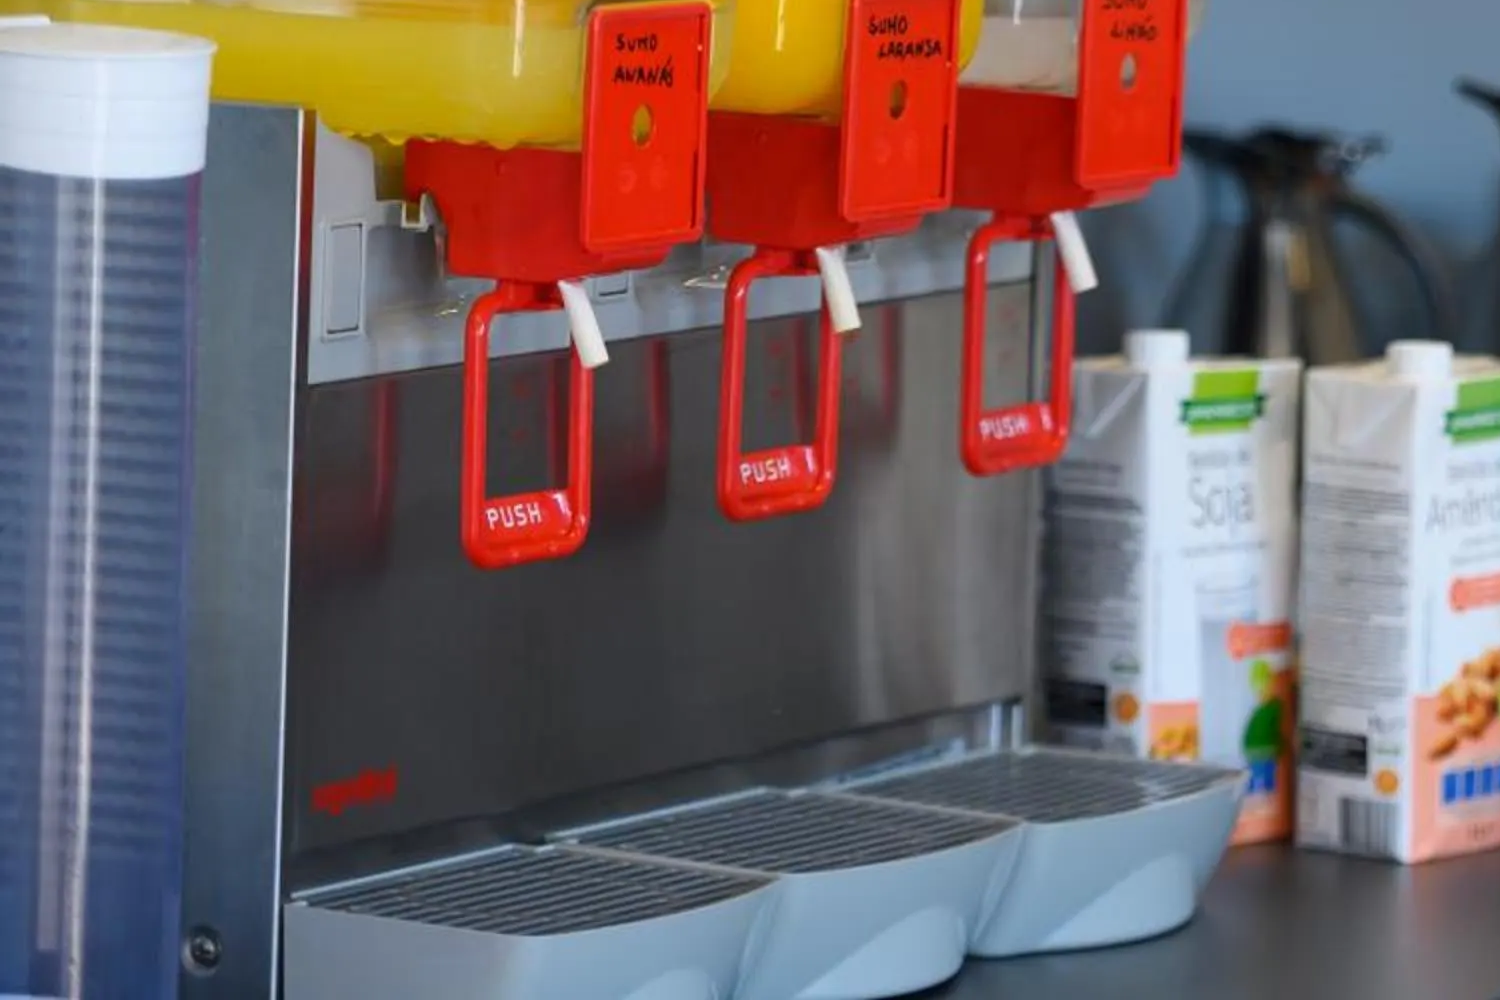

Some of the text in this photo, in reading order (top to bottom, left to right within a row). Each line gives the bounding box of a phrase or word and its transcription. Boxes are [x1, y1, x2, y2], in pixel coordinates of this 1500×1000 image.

[867, 14, 908, 37] SUMO
[614, 32, 658, 53] SUMO
[980, 412, 1028, 442] PUSH
[739, 455, 791, 487] PUSH
[486, 501, 542, 531] PUSH
